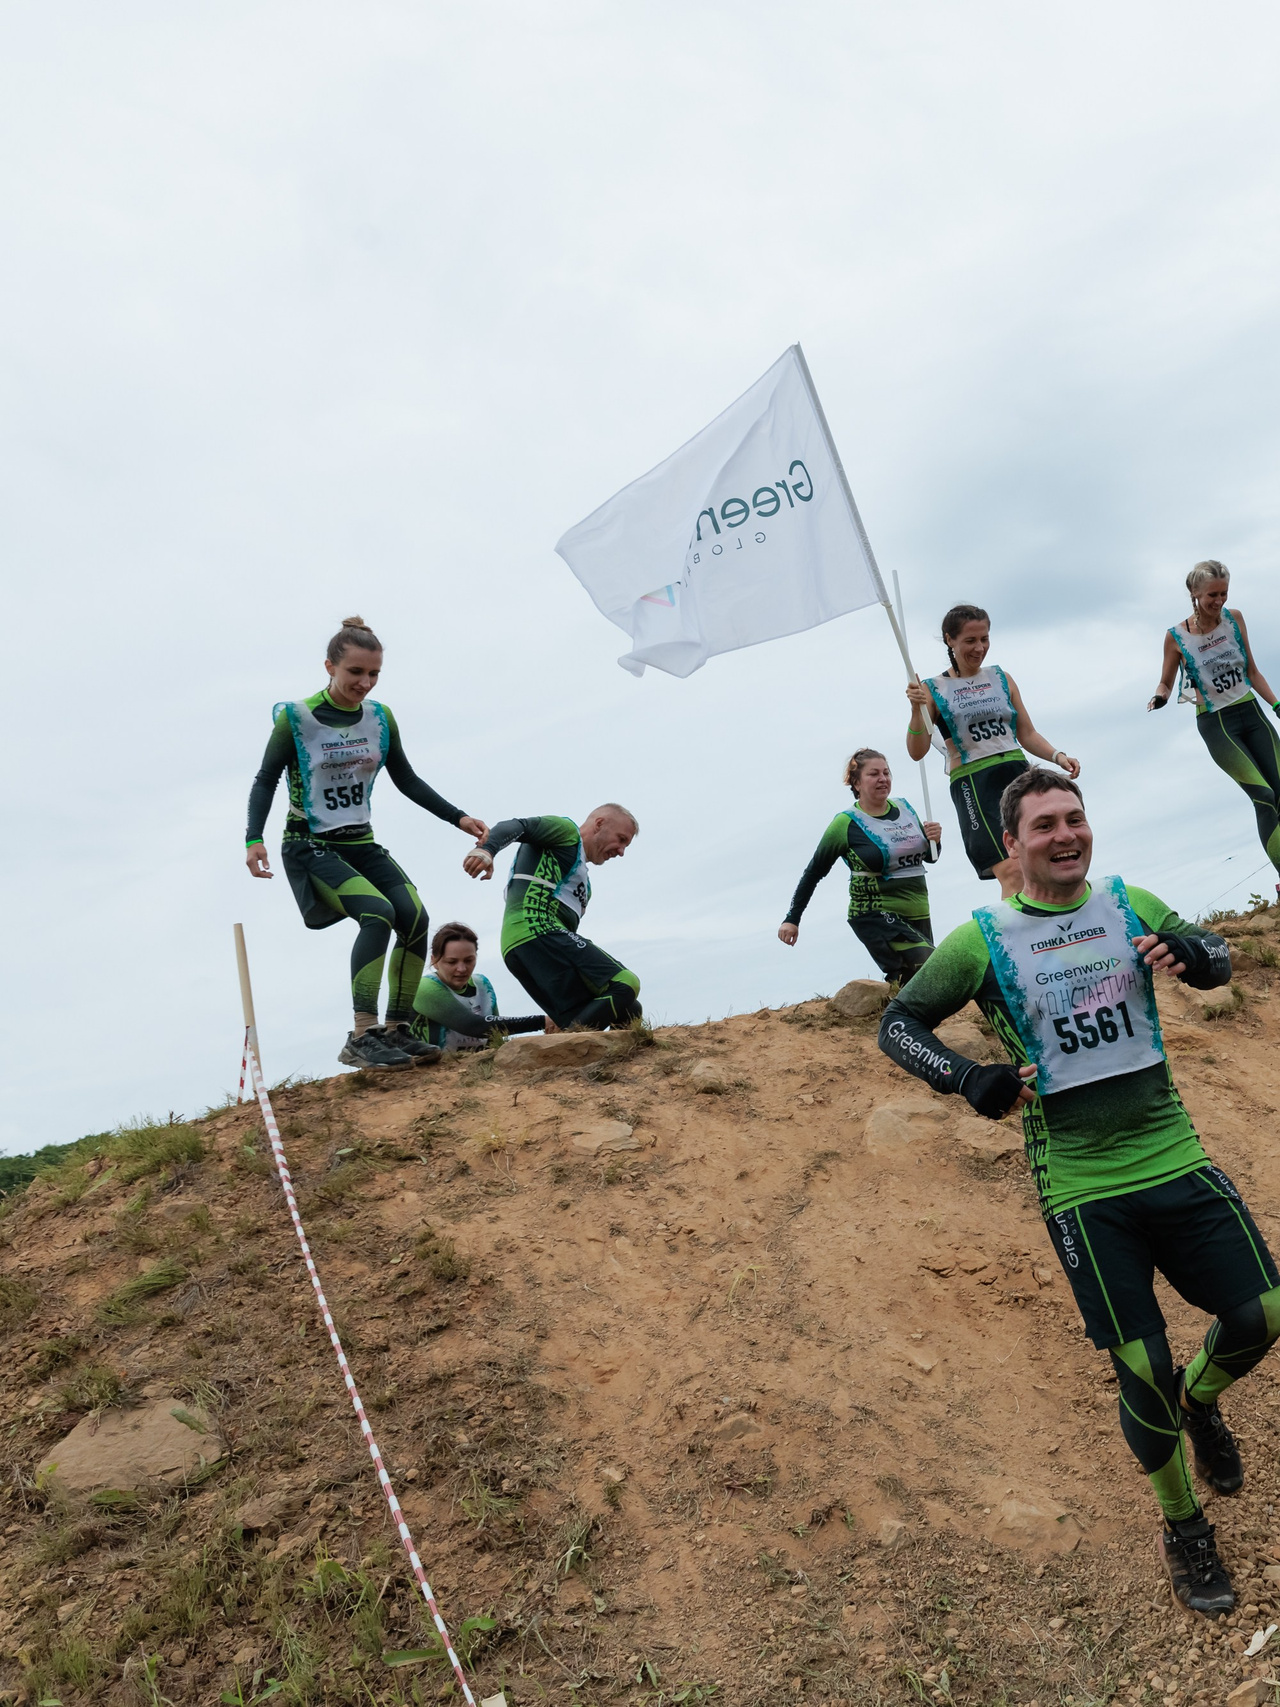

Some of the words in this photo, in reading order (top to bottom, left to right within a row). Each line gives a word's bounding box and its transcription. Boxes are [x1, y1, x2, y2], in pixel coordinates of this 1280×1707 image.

[958, 697, 998, 709] Greenway
[962, 787, 980, 830] Greenway
[1031, 936, 1066, 951] ГОНКА
[1068, 927, 1106, 942] ГЕРОЕВ
[1035, 958, 1111, 985] Greenway
[1035, 971, 1138, 1020] КОНСТАНТИН
[1053, 1001, 1135, 1055] 5561
